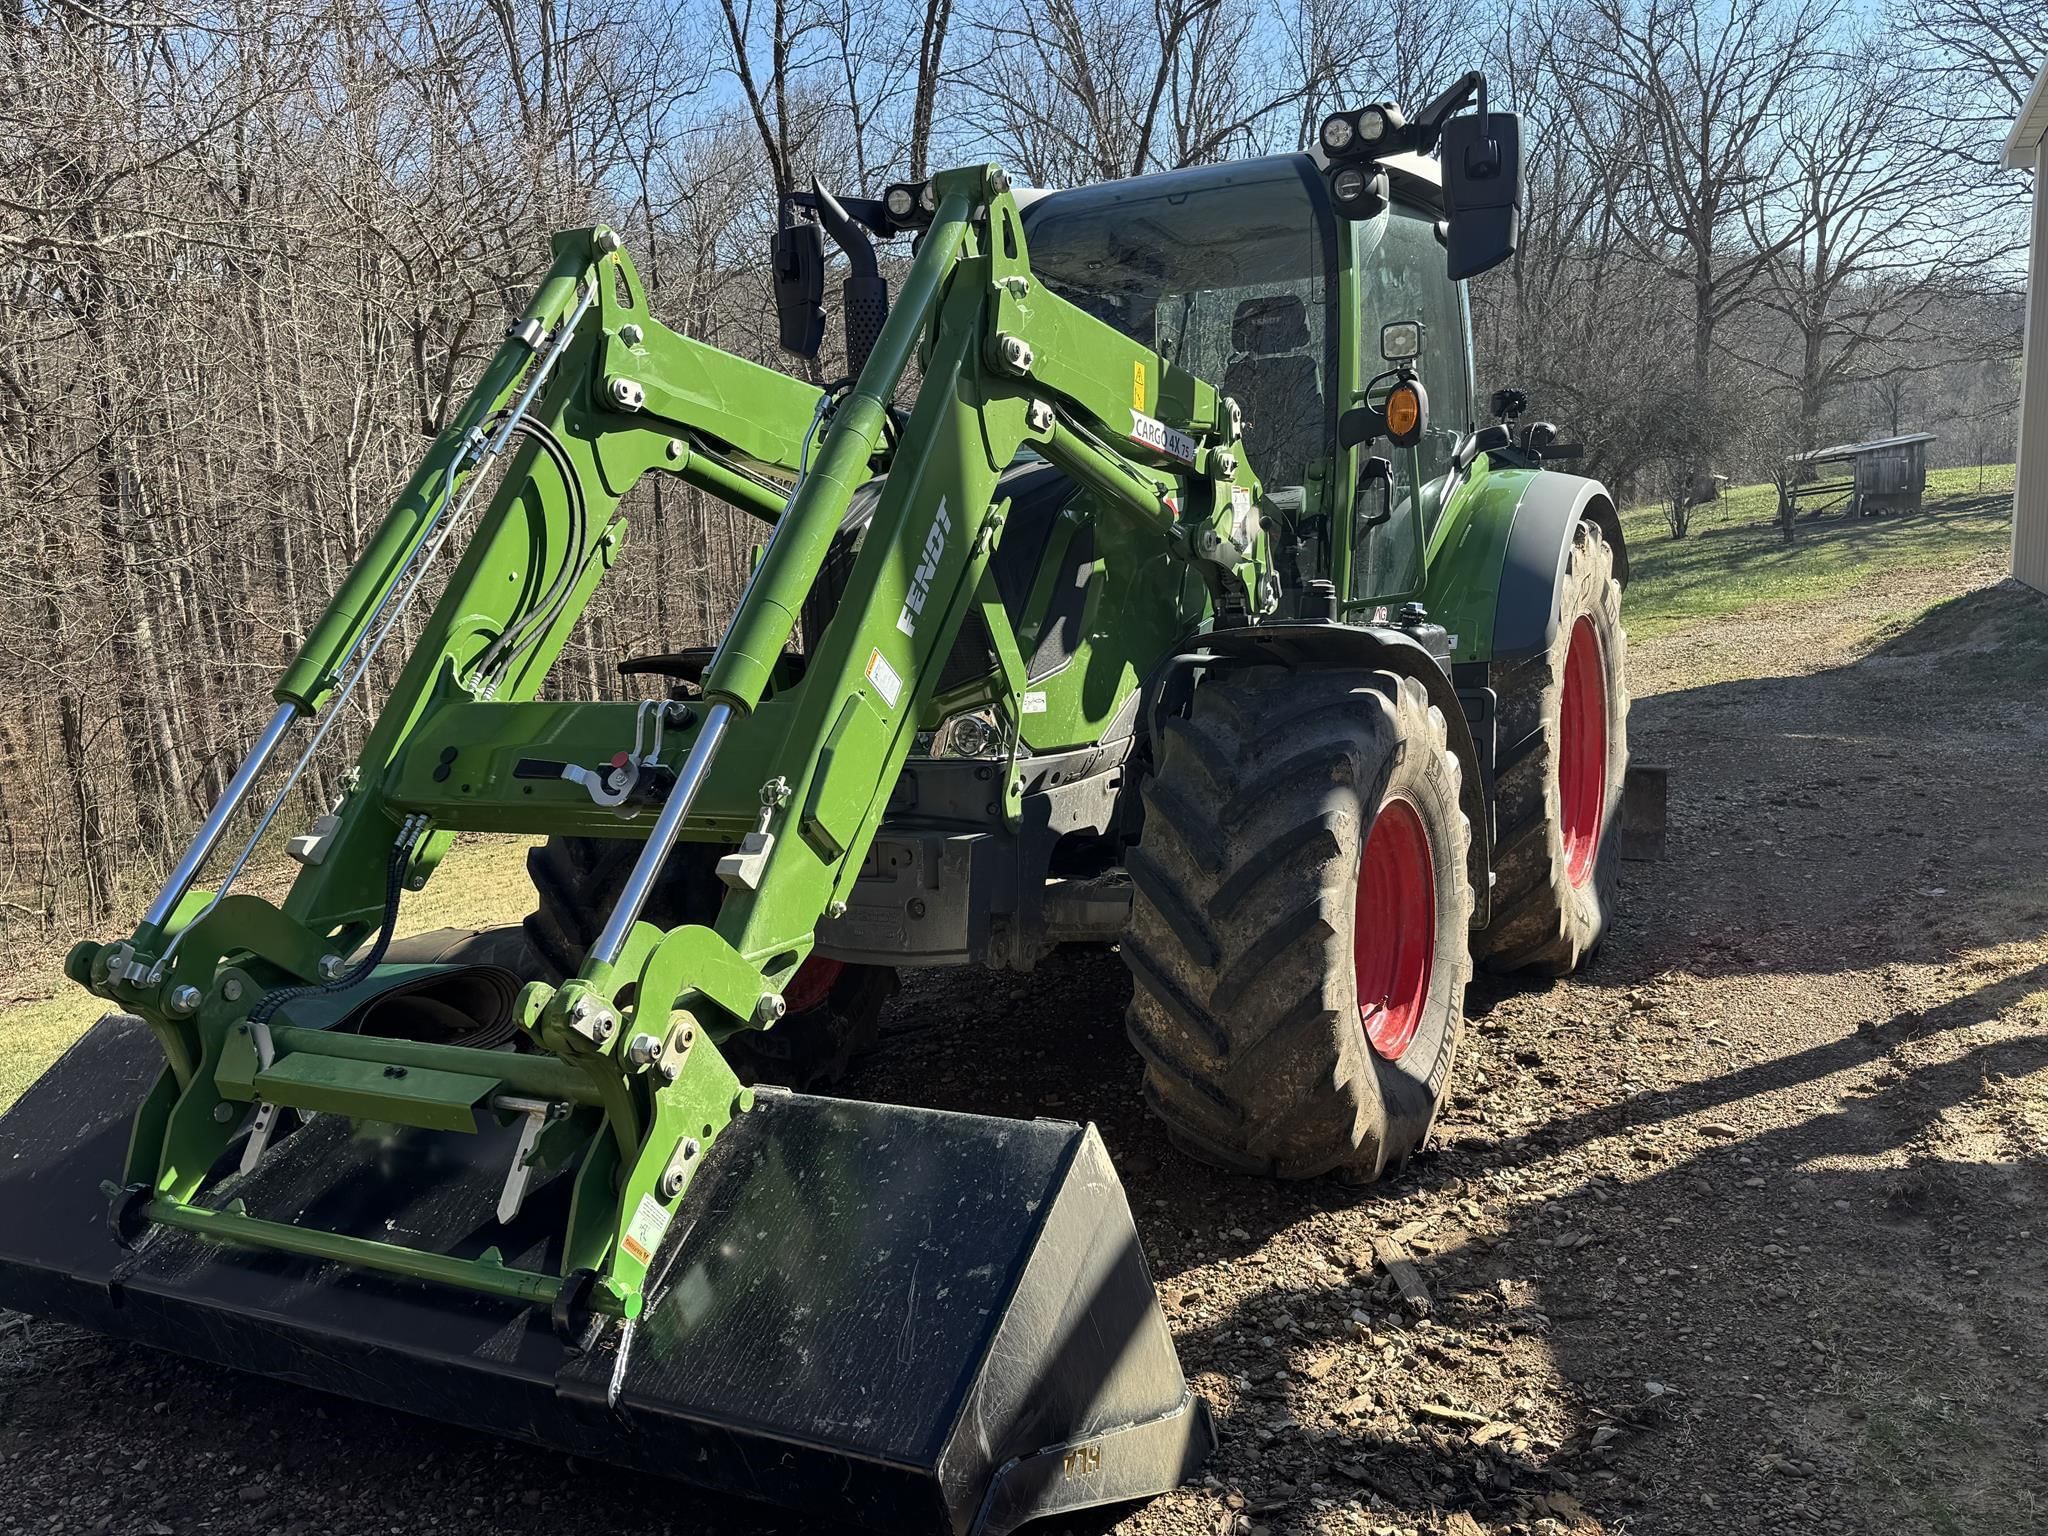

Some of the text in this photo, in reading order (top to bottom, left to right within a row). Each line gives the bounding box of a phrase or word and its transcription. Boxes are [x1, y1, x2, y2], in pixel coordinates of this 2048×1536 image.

[1136, 418, 1190, 459] CARGO 4X 75
[896, 494, 952, 639] FENDT
